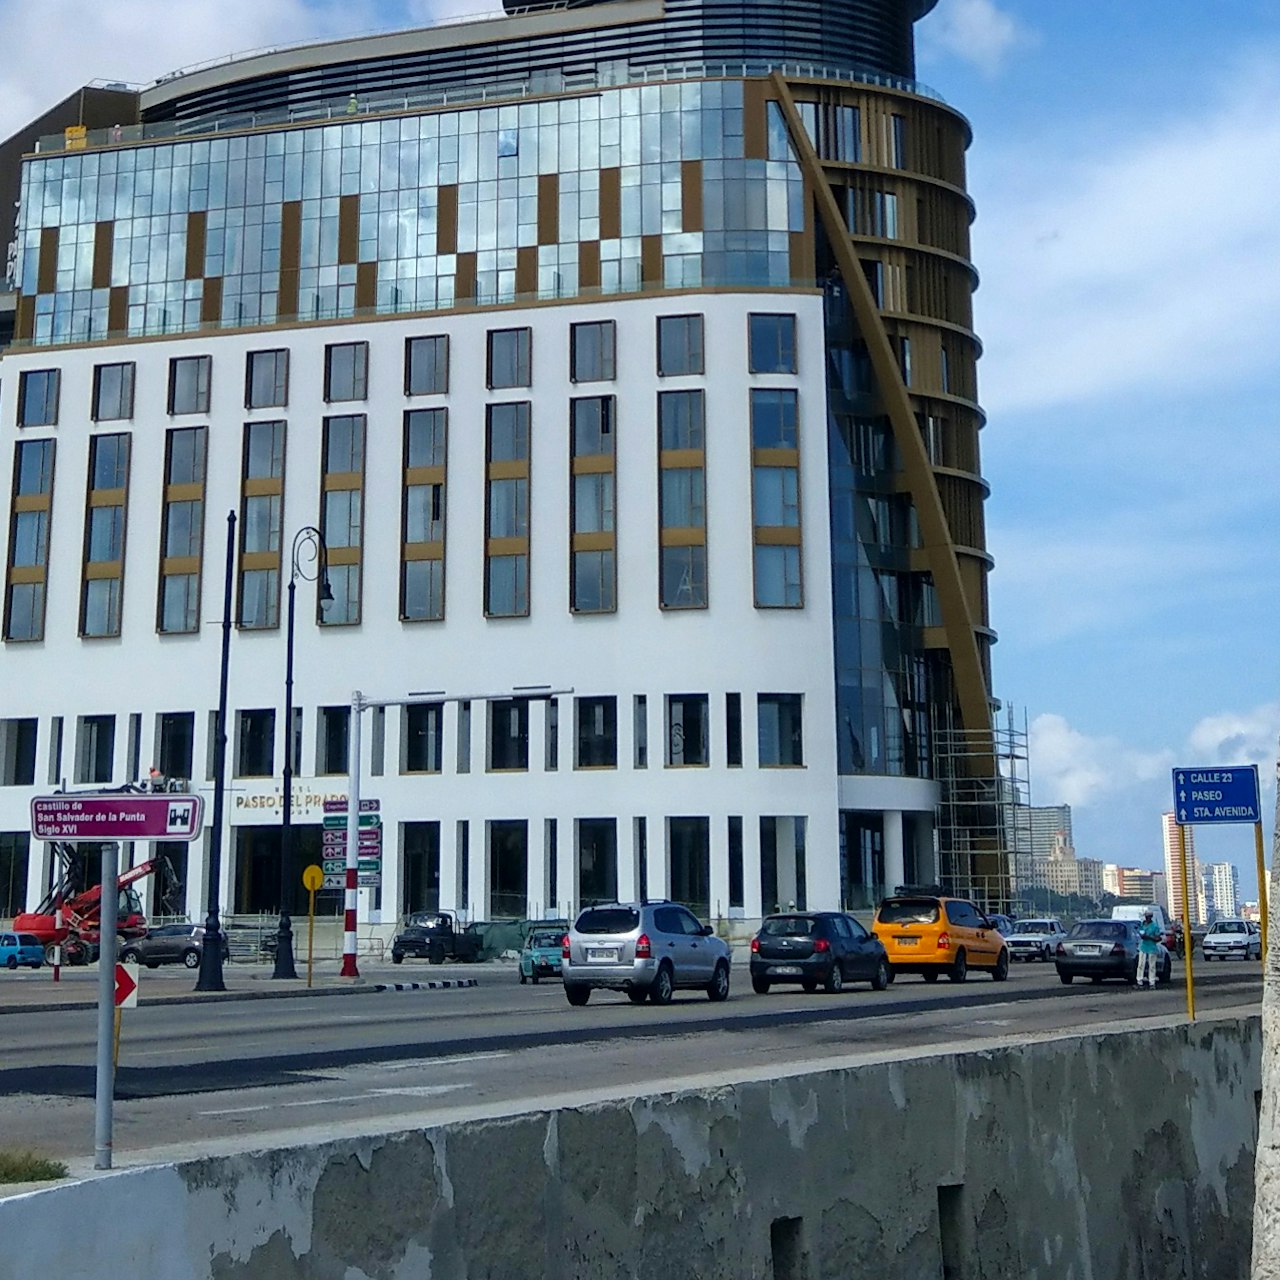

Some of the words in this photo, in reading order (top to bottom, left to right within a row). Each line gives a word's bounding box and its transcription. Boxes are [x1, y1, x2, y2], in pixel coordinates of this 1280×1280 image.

[1191, 773, 1220, 783] CALLE
[1221, 773, 1233, 782] 23
[1192, 791, 1223, 801] PASEO
[37, 802, 70, 811] castillo
[72, 802, 82, 811] de
[236, 795, 276, 809] PASEO
[1194, 807, 1213, 817] 5TA.
[1214, 806, 1255, 817] AVENIDA
[38, 813, 54, 822] San
[57, 813, 94, 822] Salvador
[96, 812, 107, 822] de
[108, 812, 117, 822] la
[119, 812, 146, 822] Punta
[38, 825, 60, 835] Siglo
[62, 824, 77, 834] XVI
